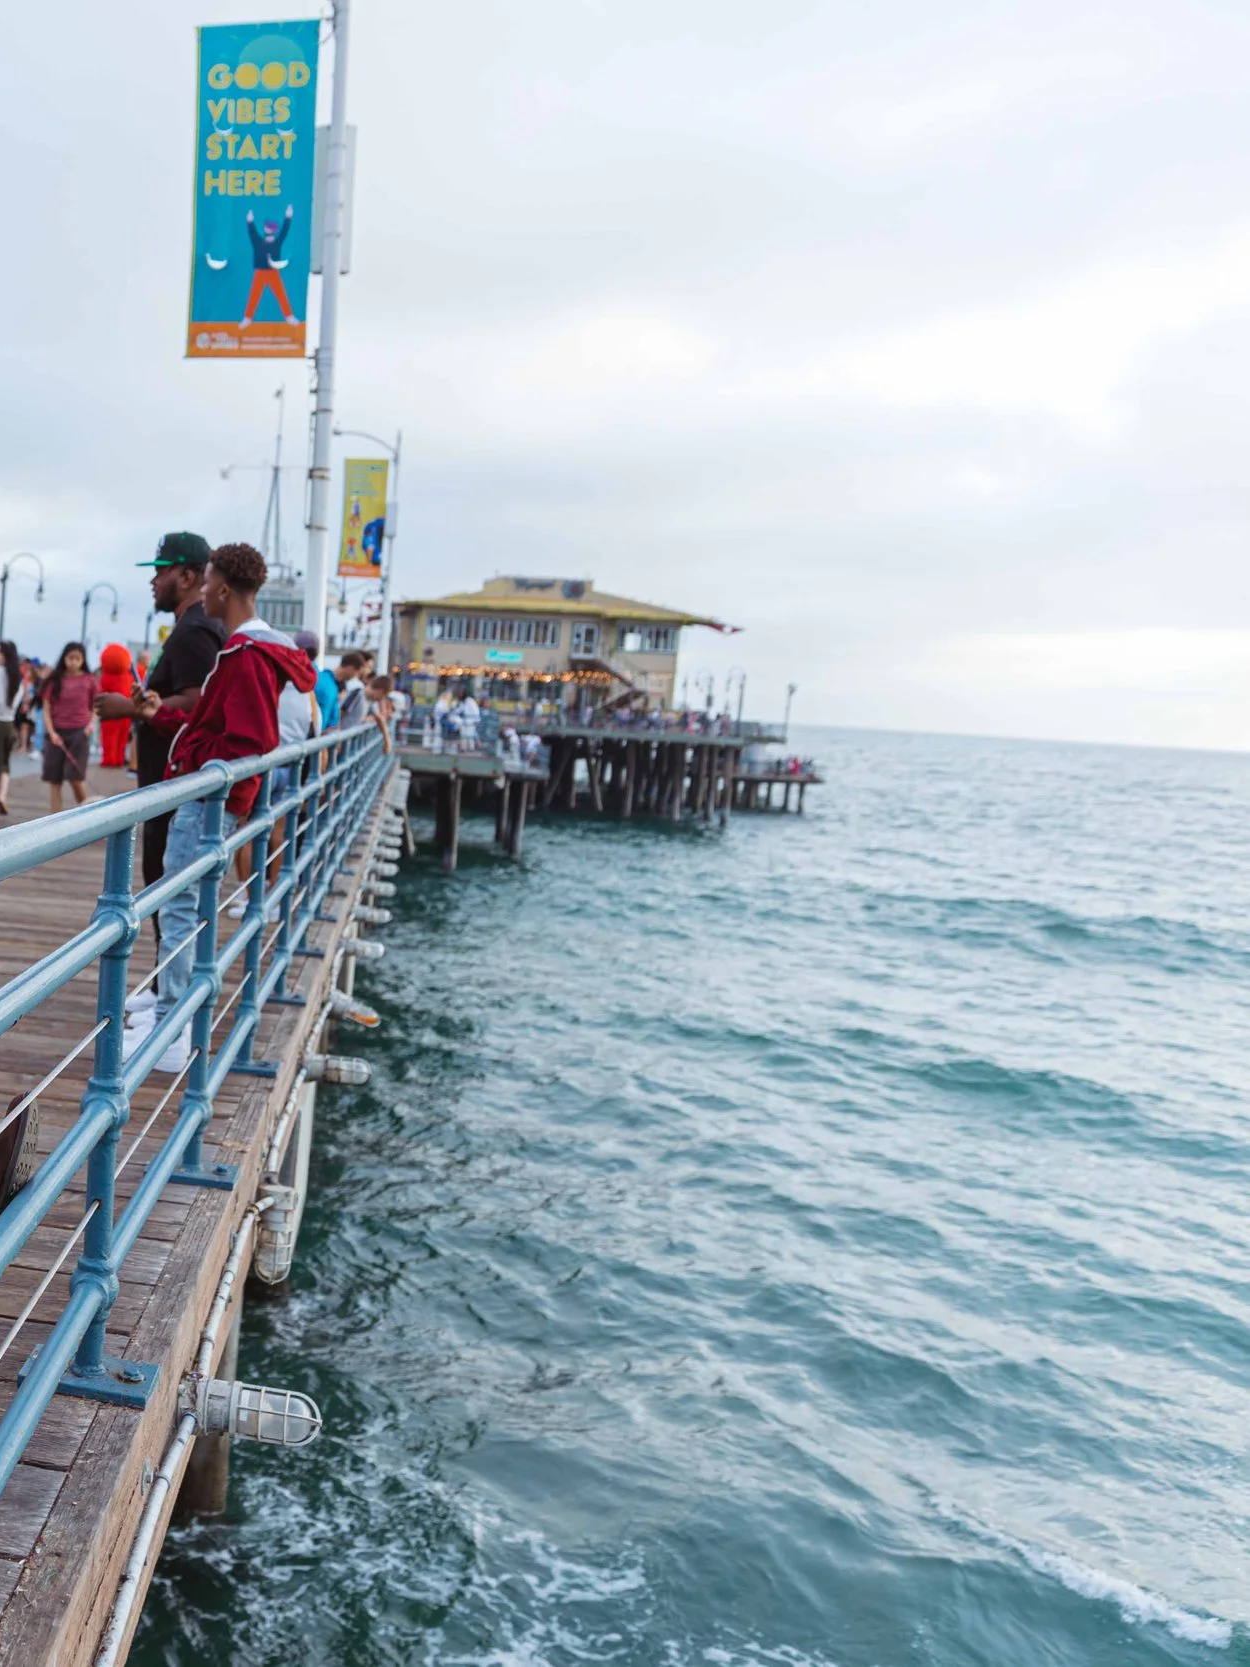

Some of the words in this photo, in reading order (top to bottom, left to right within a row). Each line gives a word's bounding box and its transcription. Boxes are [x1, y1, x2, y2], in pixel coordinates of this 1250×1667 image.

[208, 62, 310, 89] GOOD
[207, 96, 291, 124] VIBES
[206, 133, 296, 160] START
[204, 169, 281, 196] HERE
